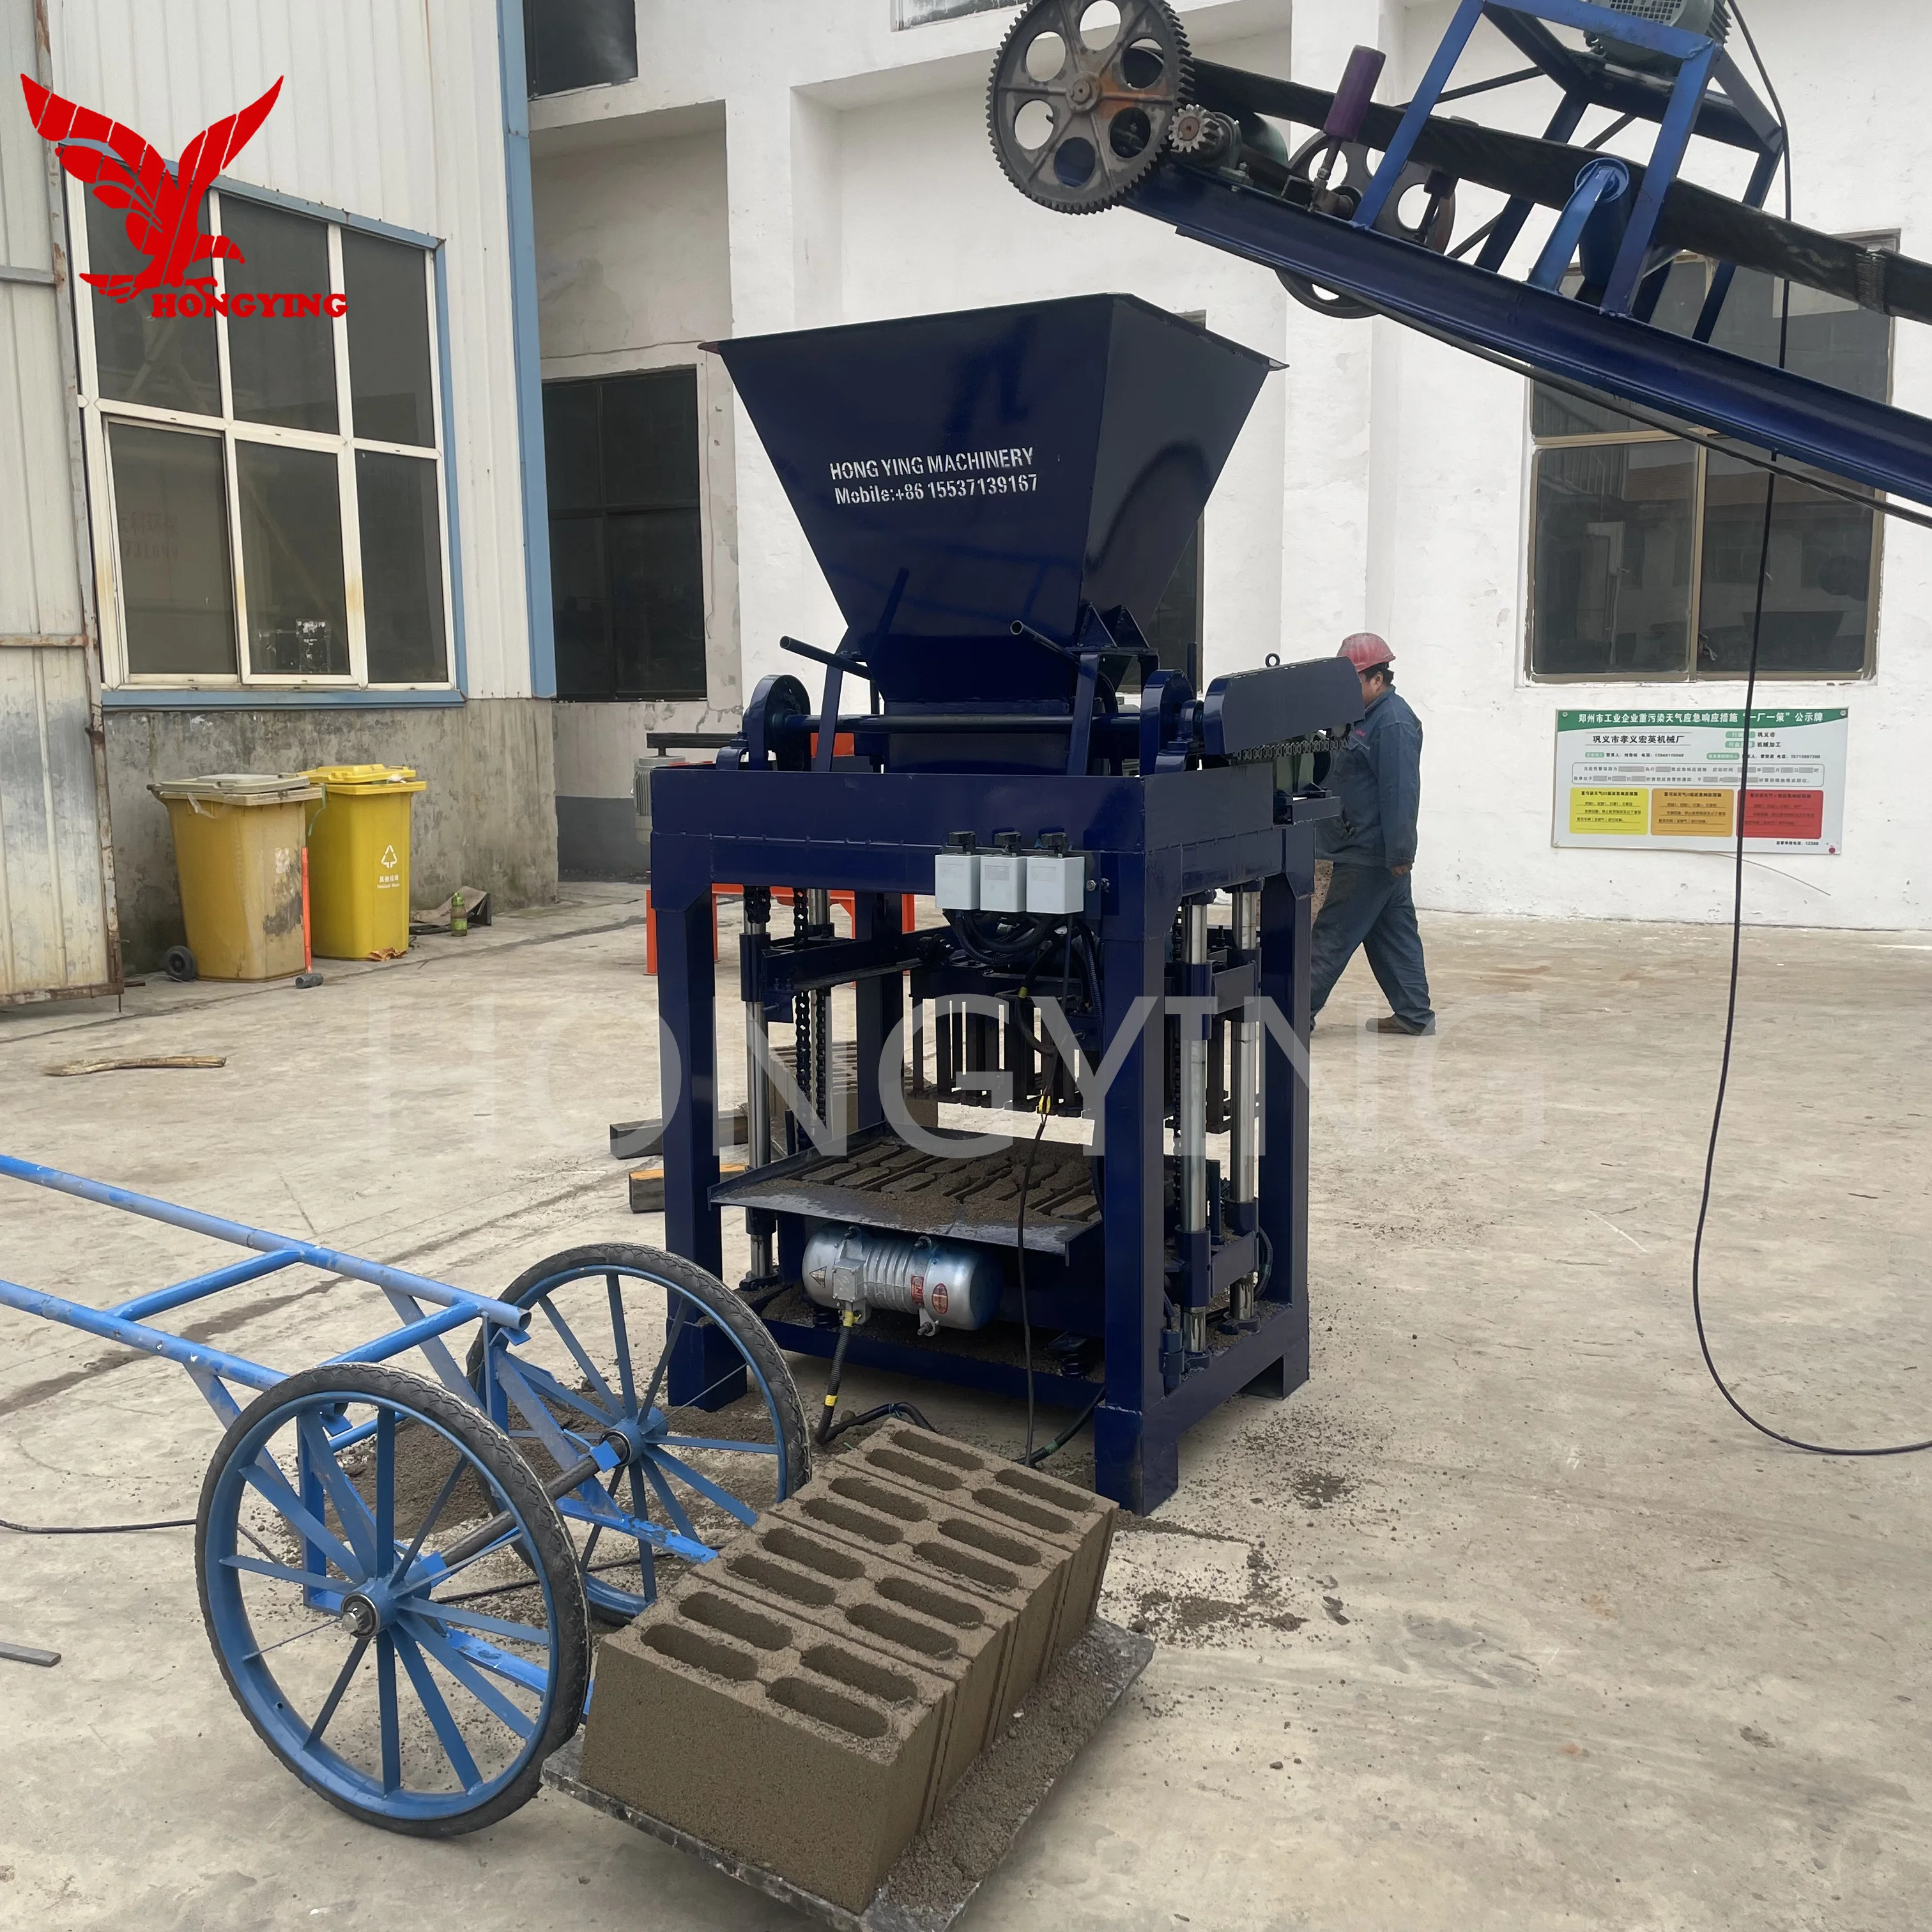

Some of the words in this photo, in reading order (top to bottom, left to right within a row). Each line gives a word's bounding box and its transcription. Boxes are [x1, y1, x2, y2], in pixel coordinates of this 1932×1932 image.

[829, 459, 878, 480] HONG
[883, 456, 924, 477] YING
[926, 447, 1034, 474] MACHINERY
[834, 482, 924, 505] Mobile:+86
[927, 473, 1038, 500] 15537139167
[1592, 735, 1685, 744] 巩义市孝义宏英机械厂
